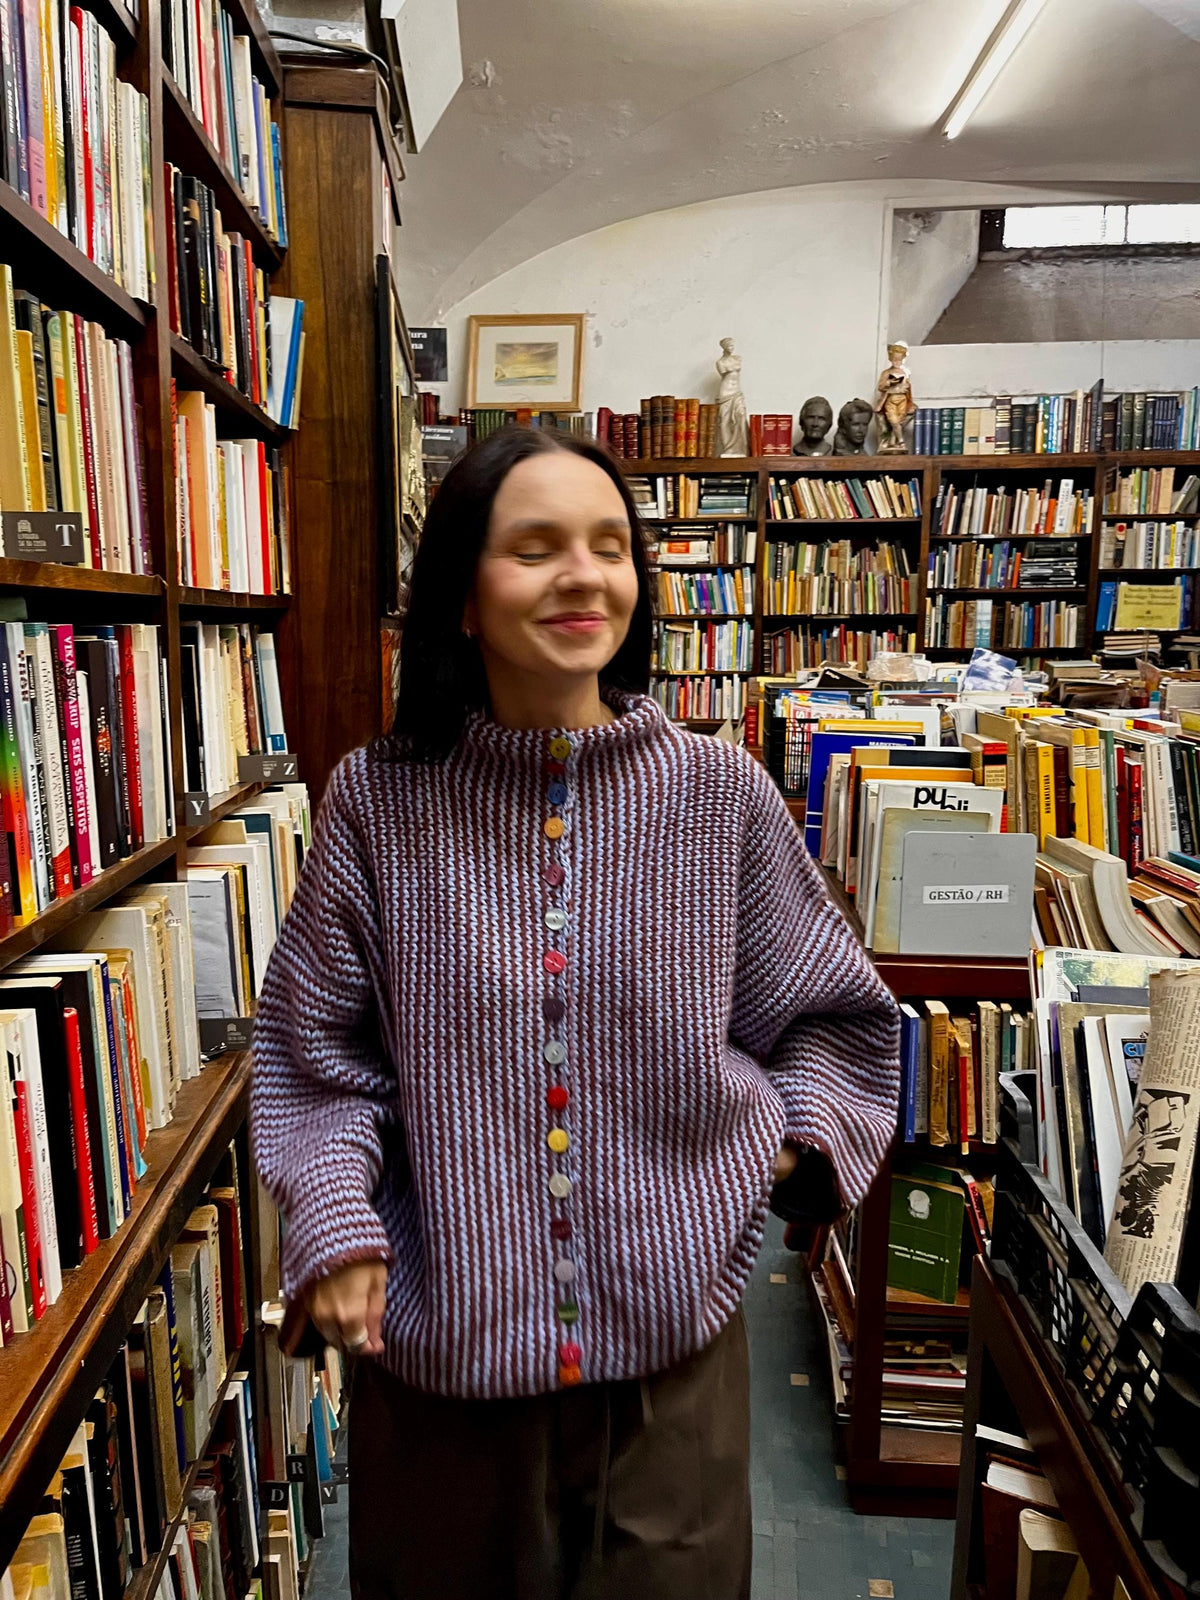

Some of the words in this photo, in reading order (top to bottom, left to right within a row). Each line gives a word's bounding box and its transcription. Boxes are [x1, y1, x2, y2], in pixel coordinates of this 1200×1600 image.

[55, 524, 76, 547] T
[63, 636, 75, 675] VIKAS
[66, 678, 81, 728] SWARUP
[5, 698, 14, 741] DIVIDIDO
[71, 737, 82, 766] SEIS
[283, 762, 296, 776] Z
[72, 768, 89, 834] SUSPEITOS
[190, 800, 205, 816] Y
[929, 889, 974, 900] GESTÃO
[976, 890, 983, 902] /
[986, 890, 1003, 900] RH
[291, 1461, 304, 1475] R
[271, 1488, 285, 1502] D
[323, 1486, 334, 1498] V
